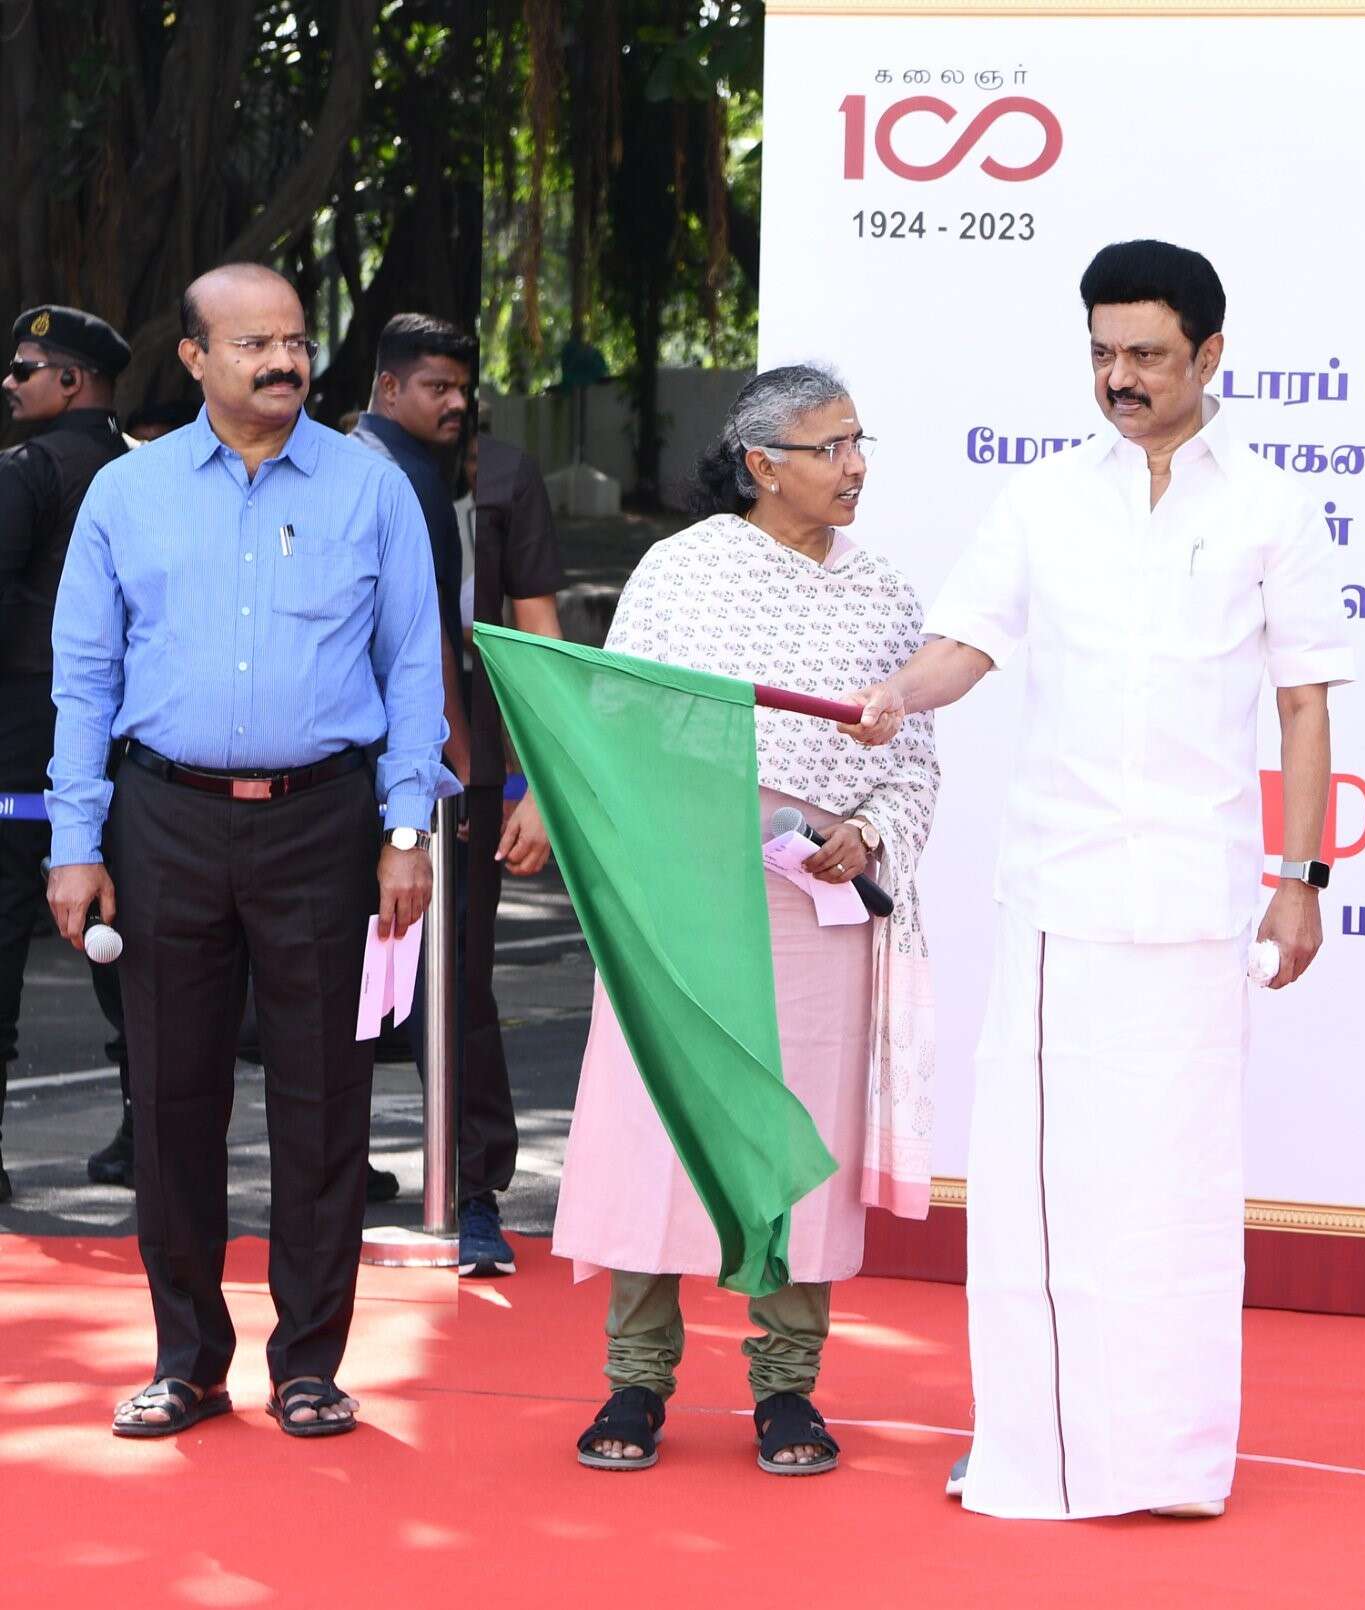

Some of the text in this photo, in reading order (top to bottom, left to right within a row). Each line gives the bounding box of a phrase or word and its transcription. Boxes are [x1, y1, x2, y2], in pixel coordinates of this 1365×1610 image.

[852, 210, 927, 239] 1924
[959, 212, 1036, 241] 2023
[1214, 357, 1348, 406] டாரப்
